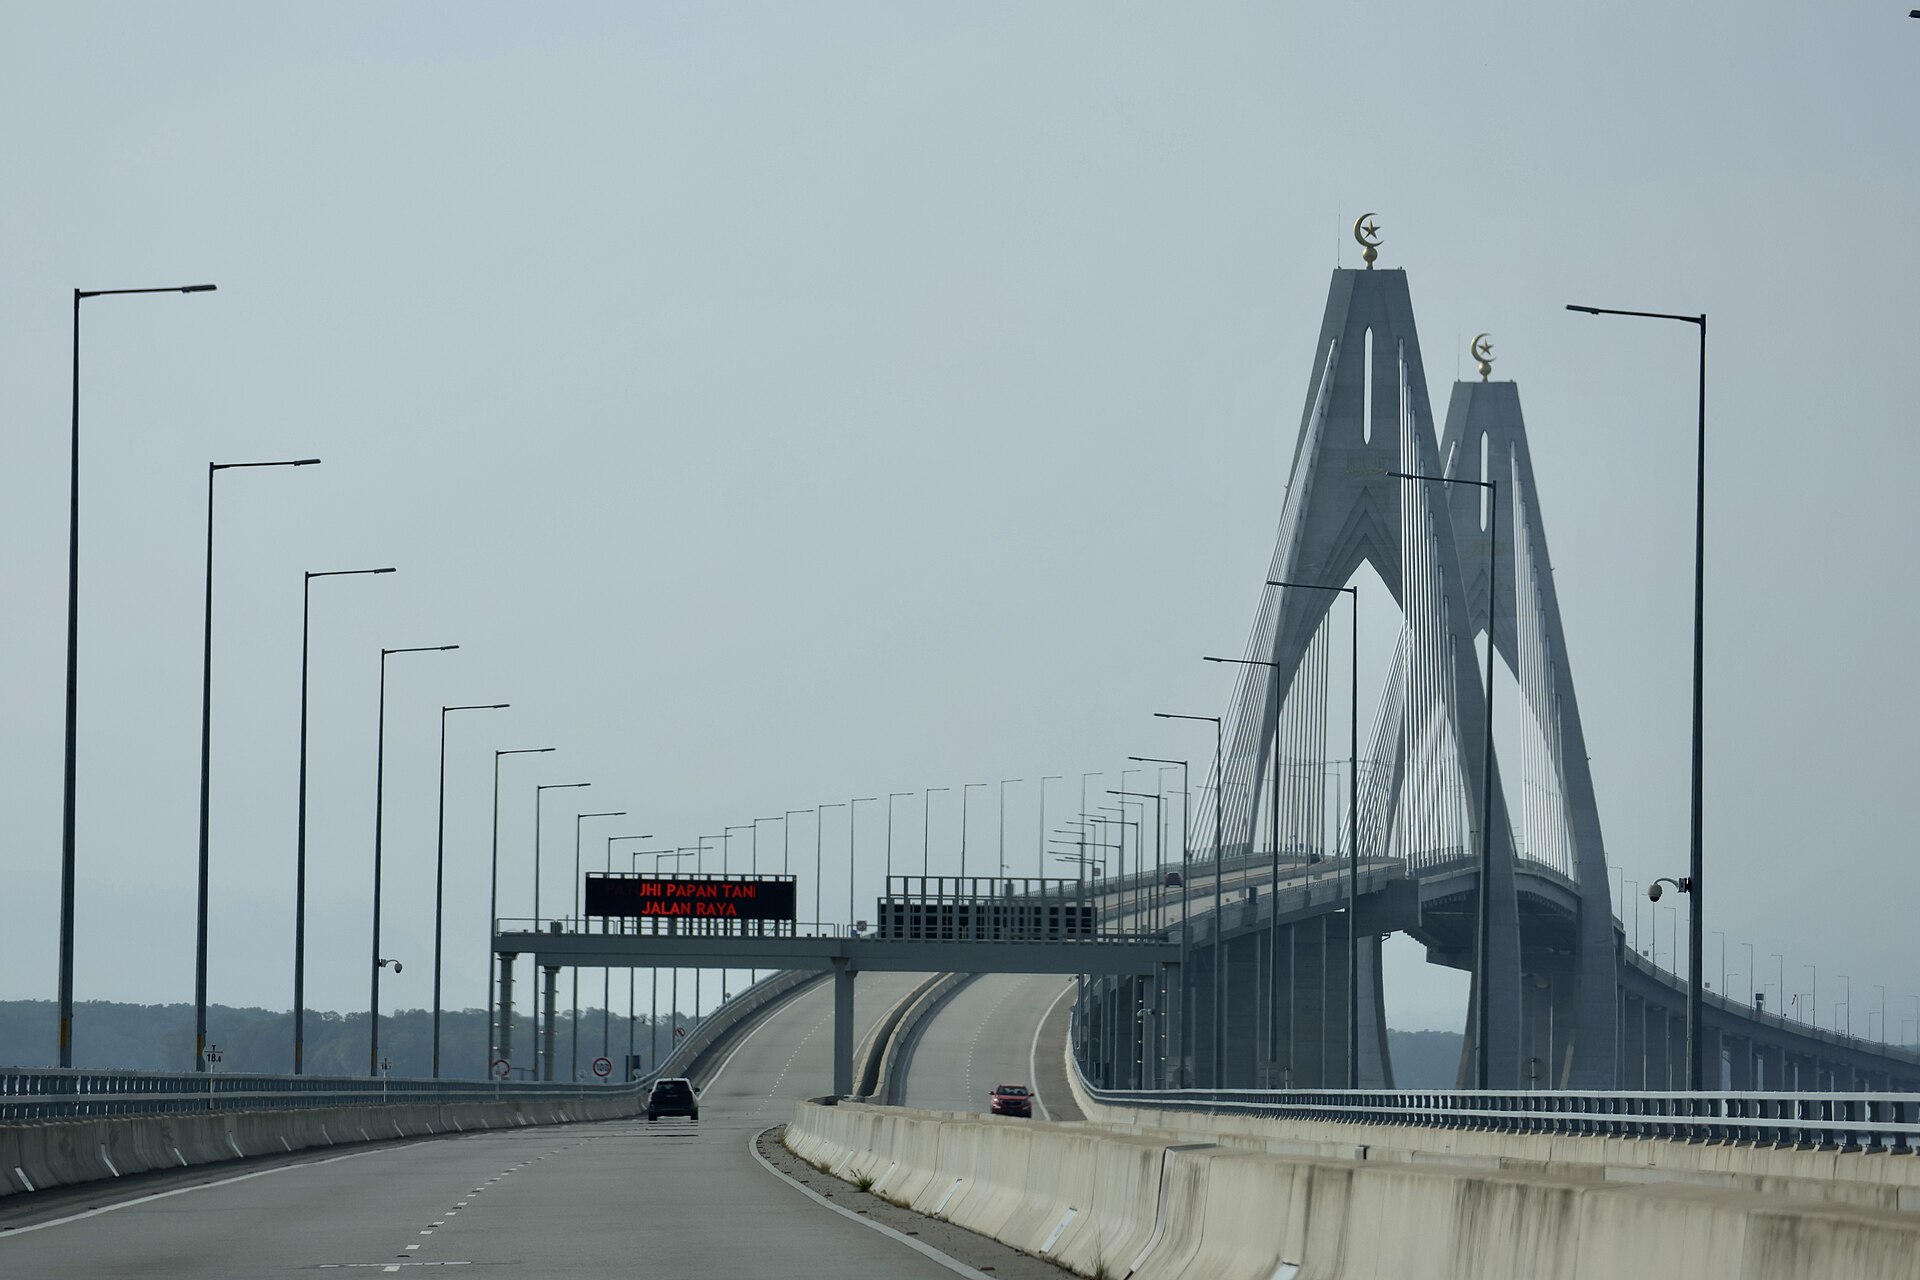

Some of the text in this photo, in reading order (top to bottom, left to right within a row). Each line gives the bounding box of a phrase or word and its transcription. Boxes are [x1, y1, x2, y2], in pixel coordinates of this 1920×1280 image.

[667, 883, 717, 898] PAPAN
[641, 901, 737, 917] JALAN RAYA
